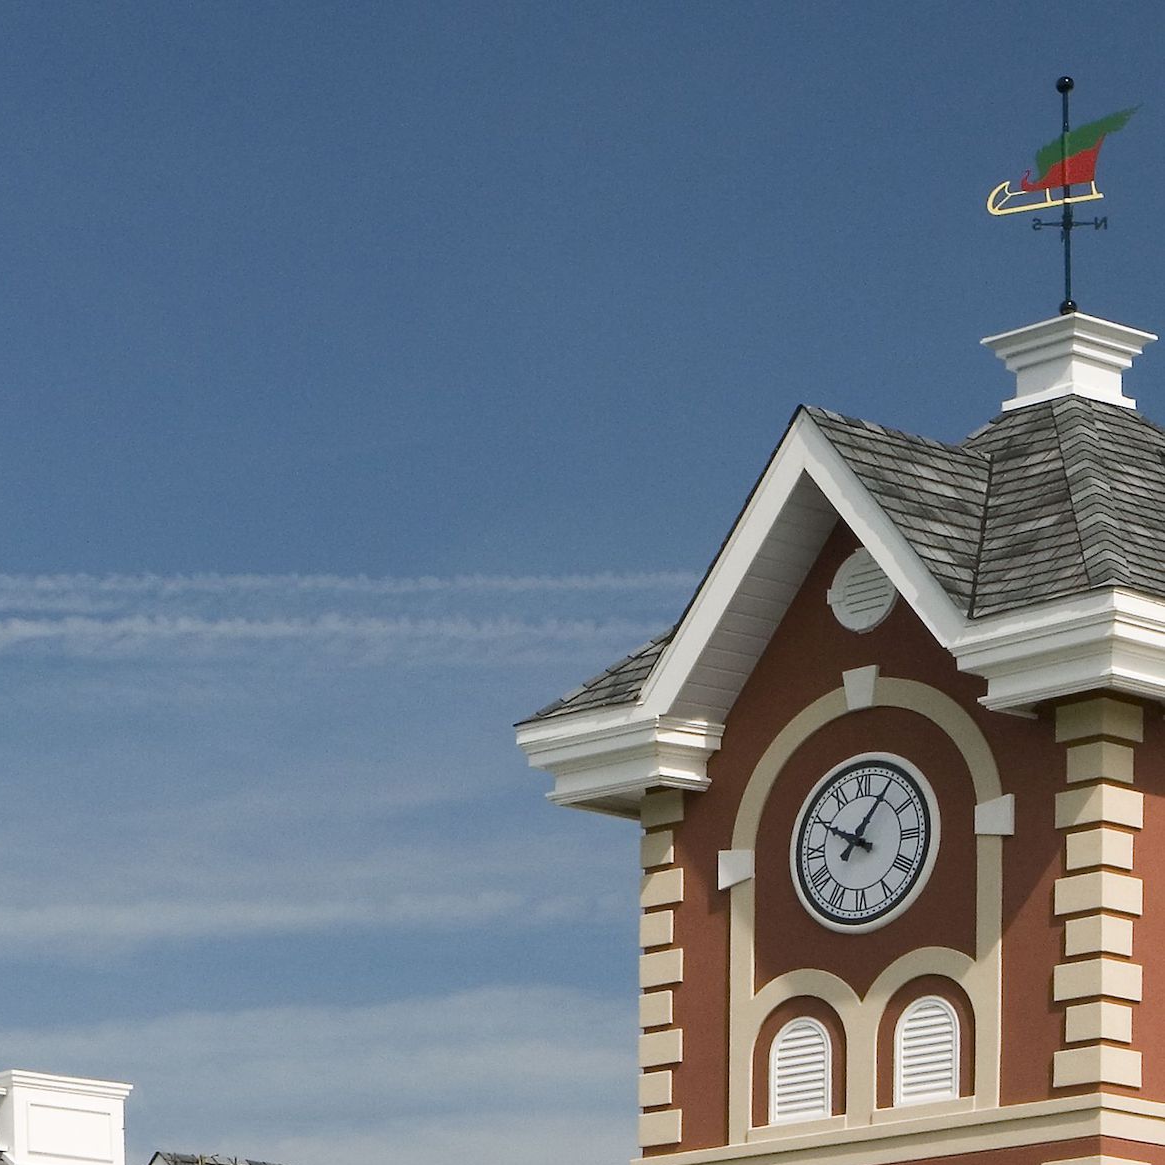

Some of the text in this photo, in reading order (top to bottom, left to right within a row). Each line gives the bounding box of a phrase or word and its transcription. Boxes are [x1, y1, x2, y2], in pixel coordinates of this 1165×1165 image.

[855, 774, 872, 799] XII
[831, 785, 849, 811] XI
[895, 799, 913, 814] II
[900, 827, 920, 840] III
[807, 844, 825, 861] IX
